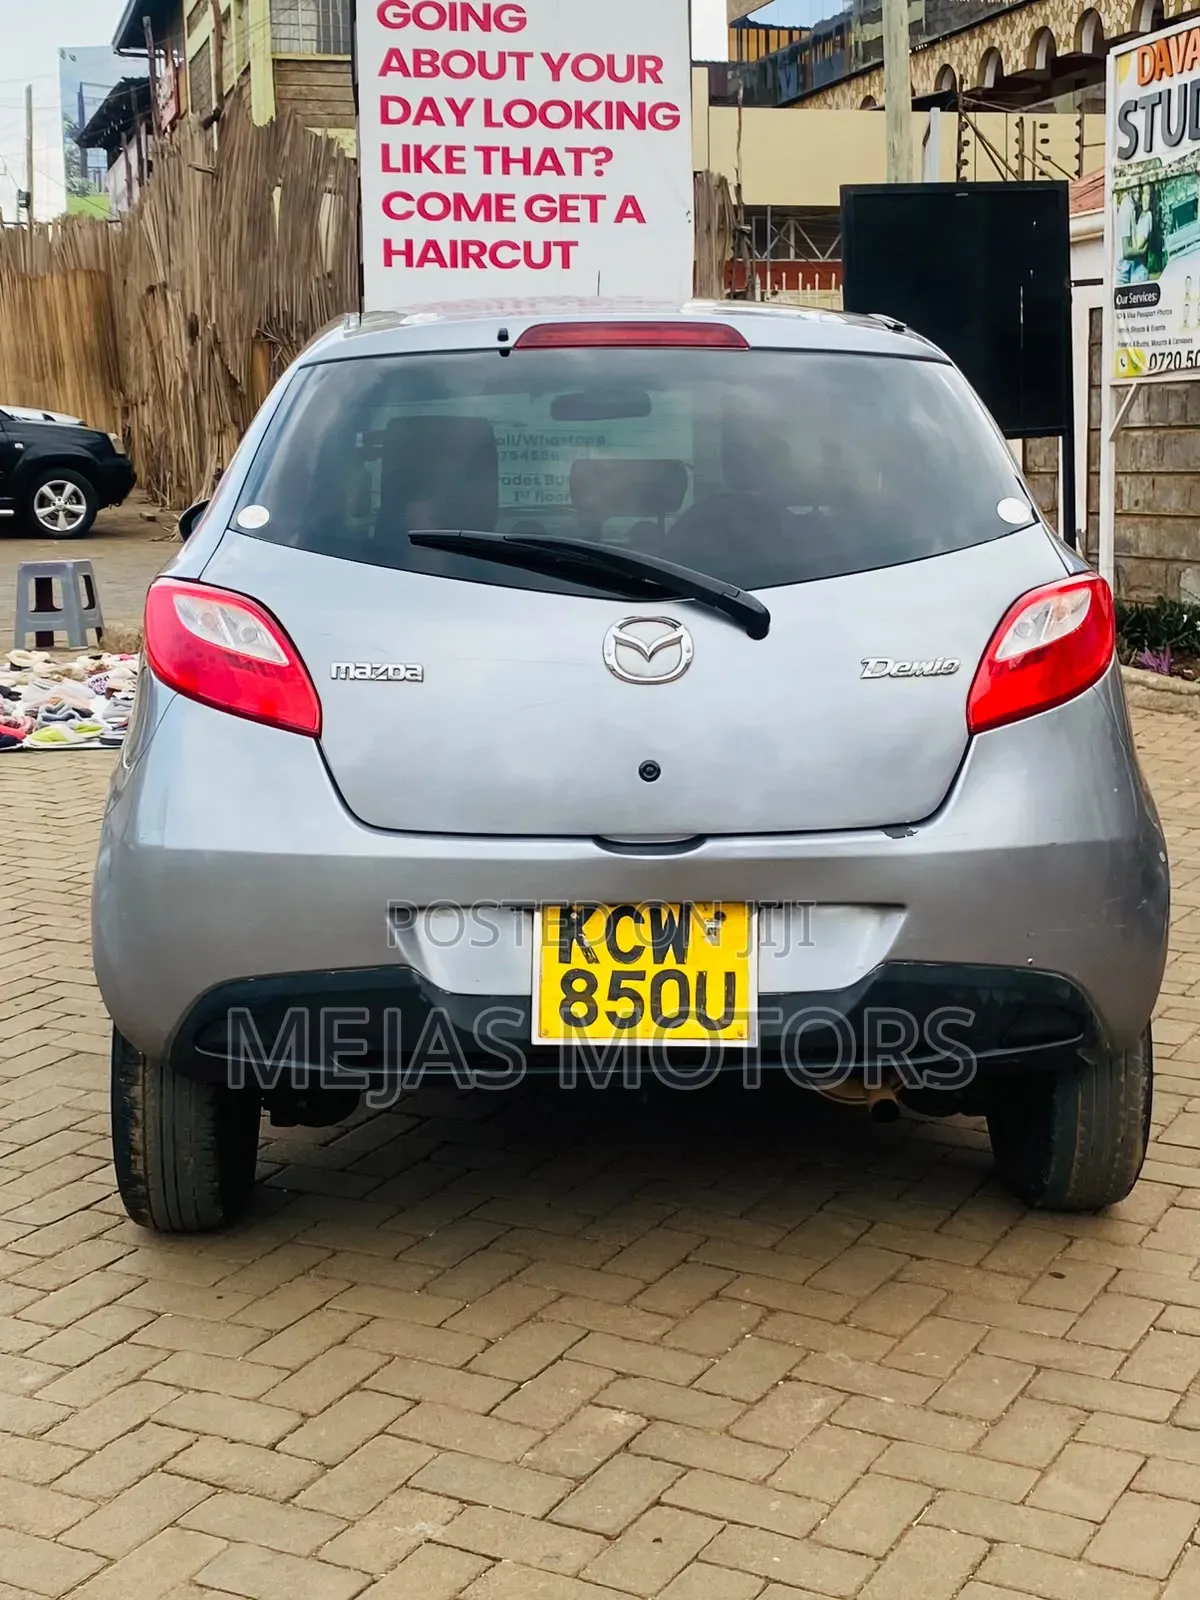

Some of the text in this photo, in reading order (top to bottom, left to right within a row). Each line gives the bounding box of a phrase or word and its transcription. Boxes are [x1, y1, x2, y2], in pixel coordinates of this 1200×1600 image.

[376, 0, 527, 33] GOING
[378, 48, 664, 84] ABOUT YOUR
[379, 95, 681, 131] DAY LOOKING
[380, 143, 614, 177] LIKE THAT?
[381, 191, 647, 224] COME GET A
[383, 238, 579, 270] HAIRCUT
[1116, 294, 1129, 306] Our
[330, 661, 424, 682] mazda
[860, 656, 961, 679] Demio
[558, 905, 692, 965] KCW
[559, 968, 736, 1031] 850U
